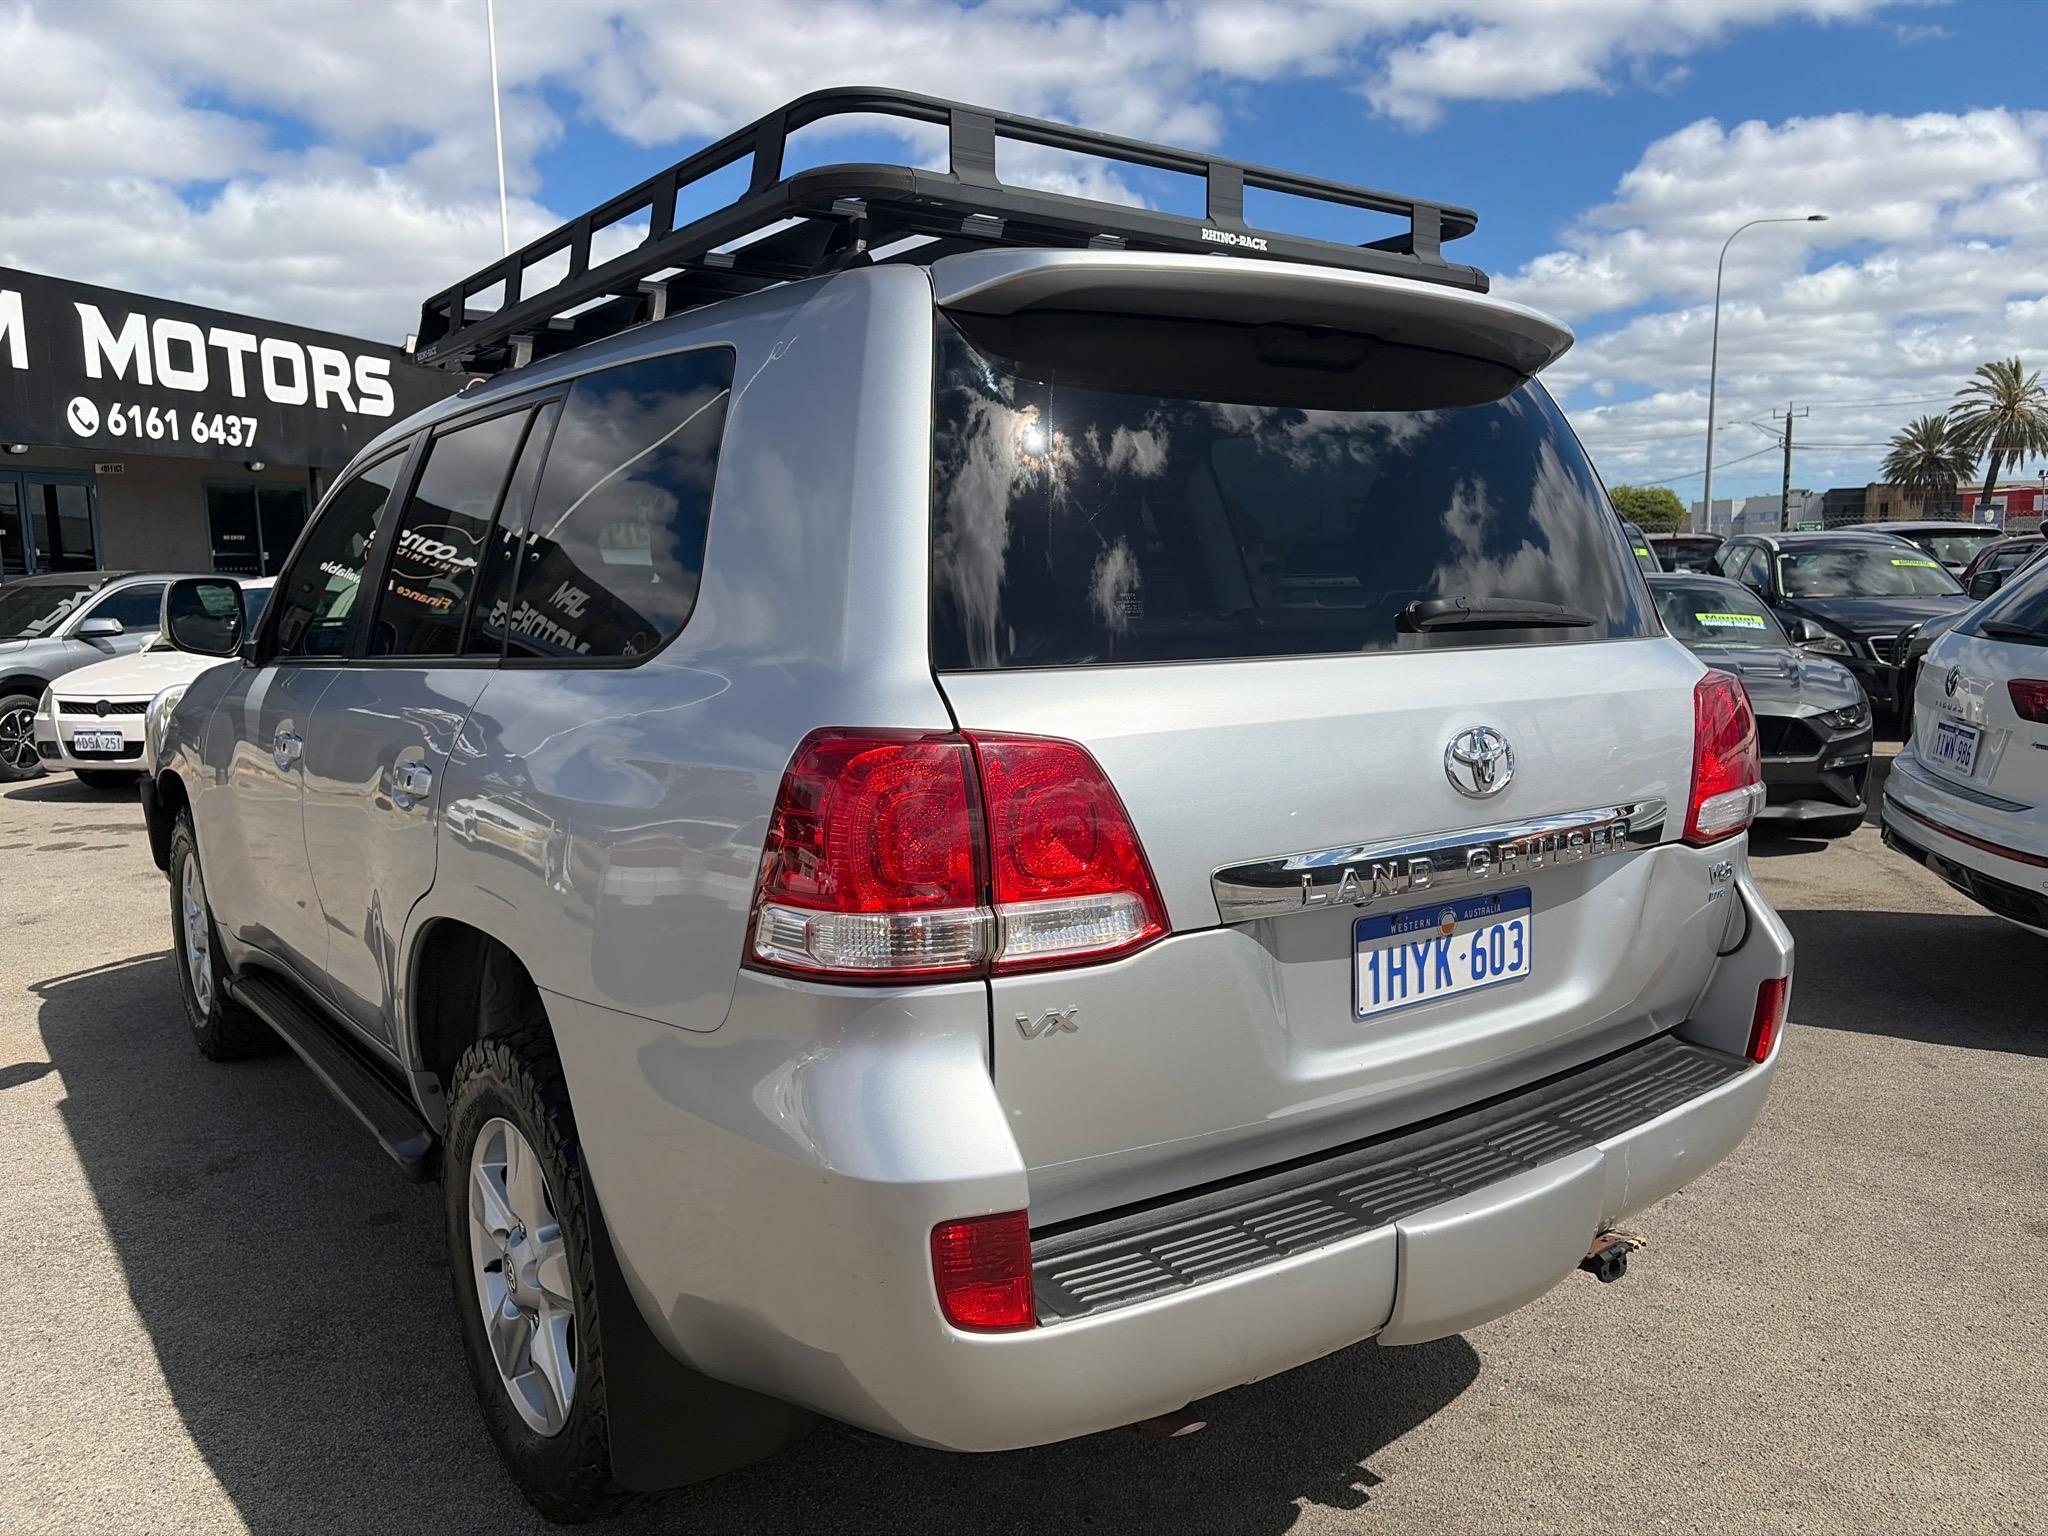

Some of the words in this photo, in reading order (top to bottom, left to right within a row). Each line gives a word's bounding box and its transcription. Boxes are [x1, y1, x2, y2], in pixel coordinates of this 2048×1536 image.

[1201, 228, 1268, 251] RHINO-RACK
[74, 302, 394, 417] MOTORS
[107, 403, 180, 441] 6161
[191, 412, 258, 448] 6437
[1301, 856, 1434, 906] LAND
[1466, 822, 1628, 880] CRUISER
[1391, 918, 1431, 934] WESTERN
[1463, 903, 1501, 920] AUSTRALIA
[1015, 1006, 1079, 1039] VX
